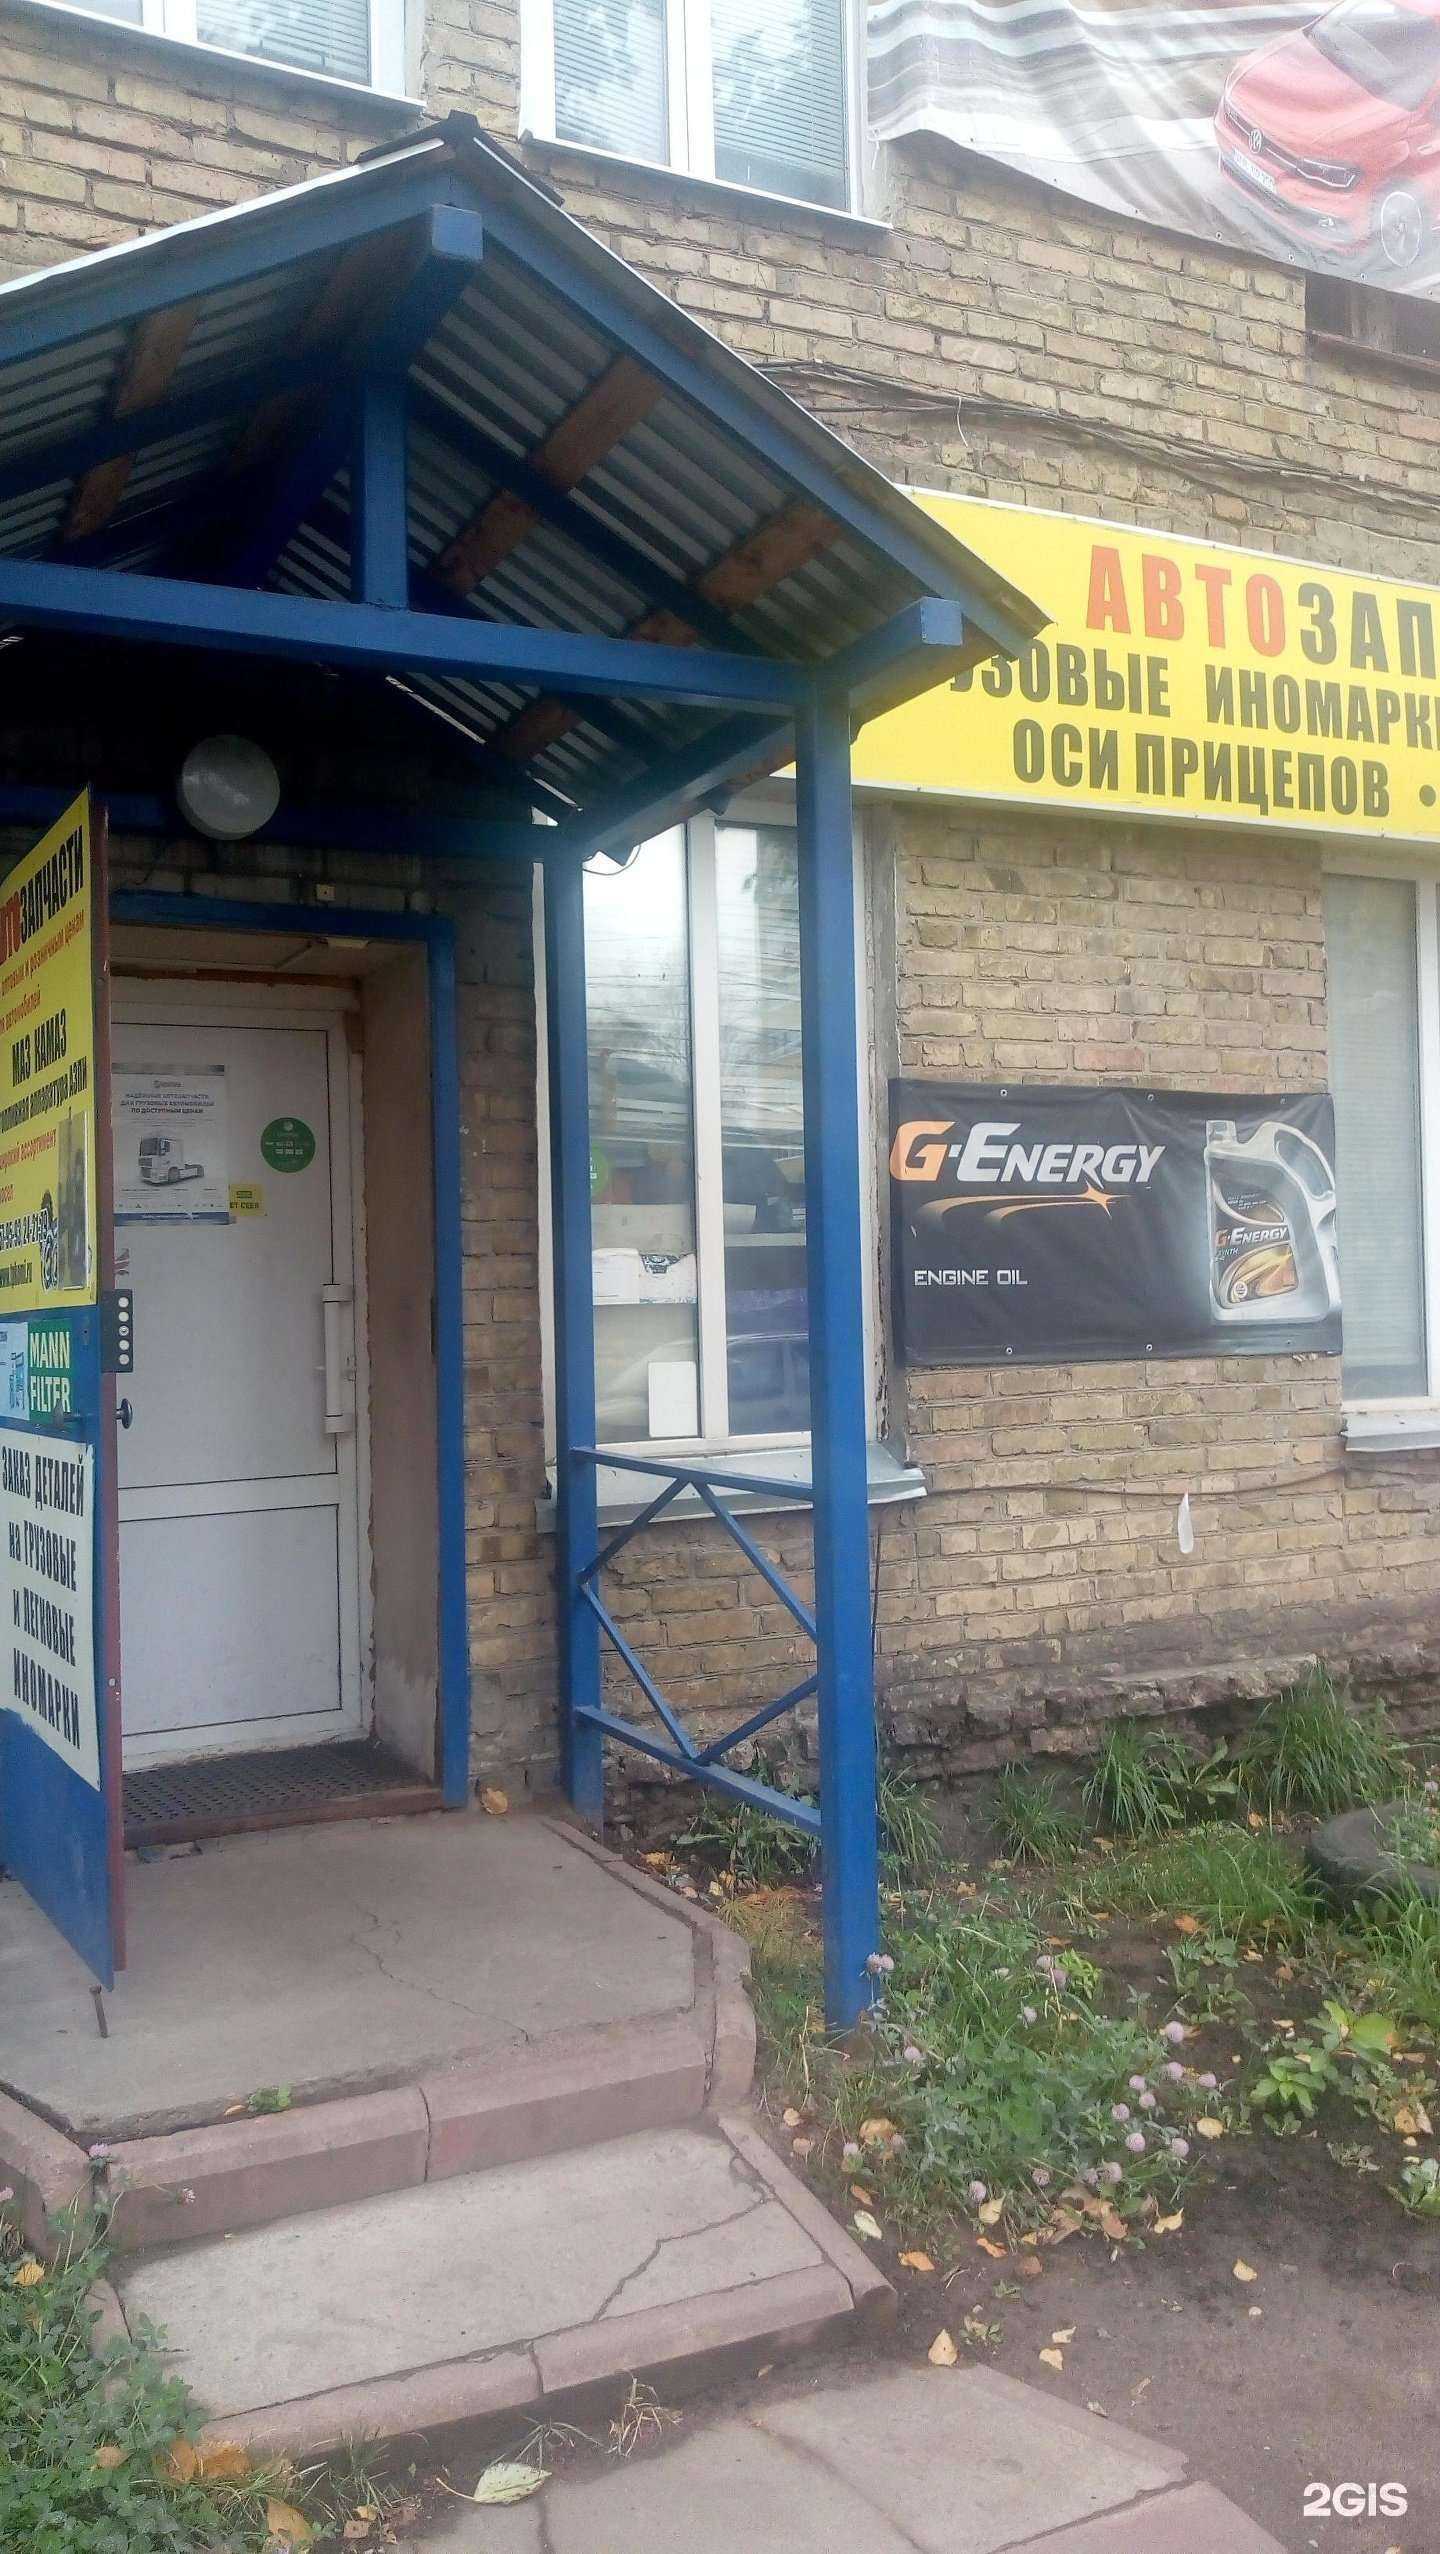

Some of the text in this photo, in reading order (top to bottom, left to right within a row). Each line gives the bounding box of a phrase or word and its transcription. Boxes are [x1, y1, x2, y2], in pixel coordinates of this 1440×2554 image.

[1087, 545, 1437, 679] АВТОЗАП
[1013, 718, 1390, 817] ОСИ ПРИЦЕПОВ
[12, 1008, 67, 1087] МАЗ КАМАЗ
[914, 1269, 1028, 1287] ENGINE OIL
[30, 1331, 70, 1369] MANN
[30, 1375, 71, 1413] FILTER
[2, 1445, 84, 1517] ЗАКАЗ ДЕТАЛЕЙ
[23, 1519, 77, 1591] ГРУЗОВЫЕ
[23, 1586, 76, 1666] ЛЕГКОВЫЕ
[13, 1647, 81, 1750] ИНОМАРКИ
